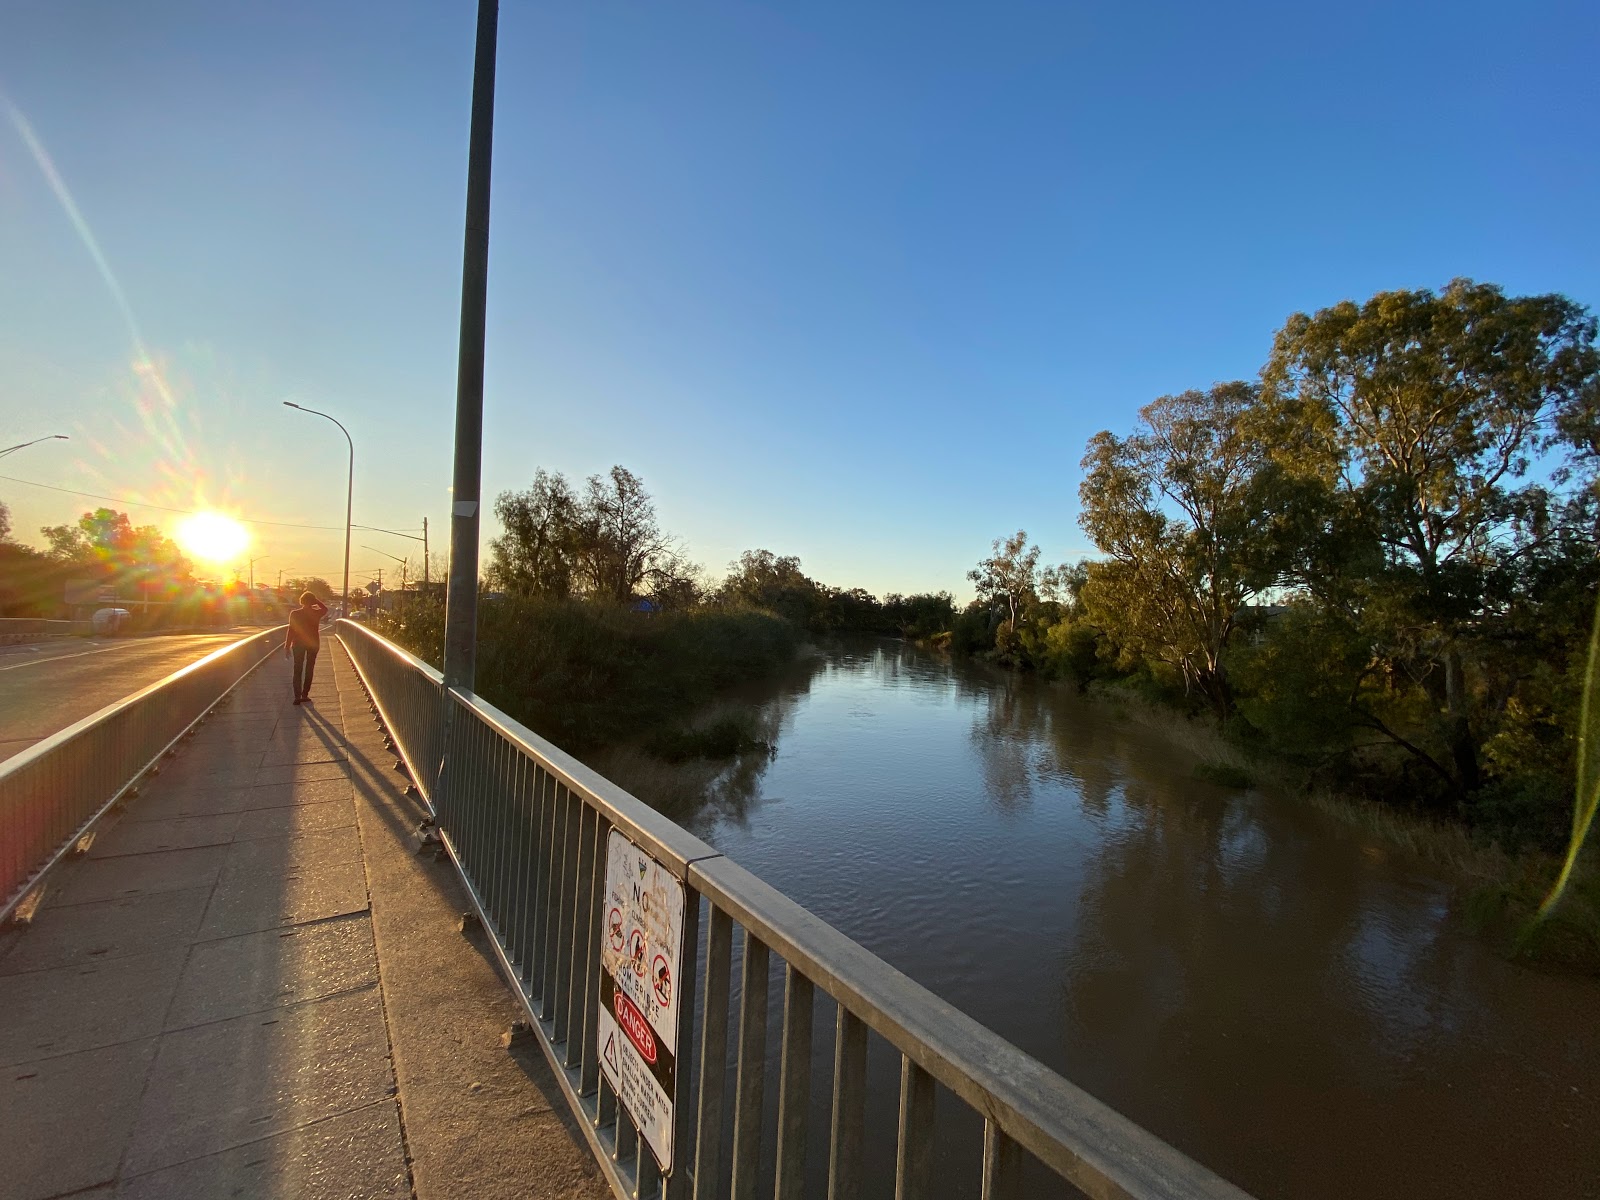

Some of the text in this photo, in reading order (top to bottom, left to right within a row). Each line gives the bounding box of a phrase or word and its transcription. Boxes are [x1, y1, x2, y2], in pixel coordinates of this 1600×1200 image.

[632, 881, 649, 912] NO
[635, 980, 660, 1018] BRIDGE
[617, 997, 652, 1057] DANGER
[656, 1091, 669, 1119] WATER
